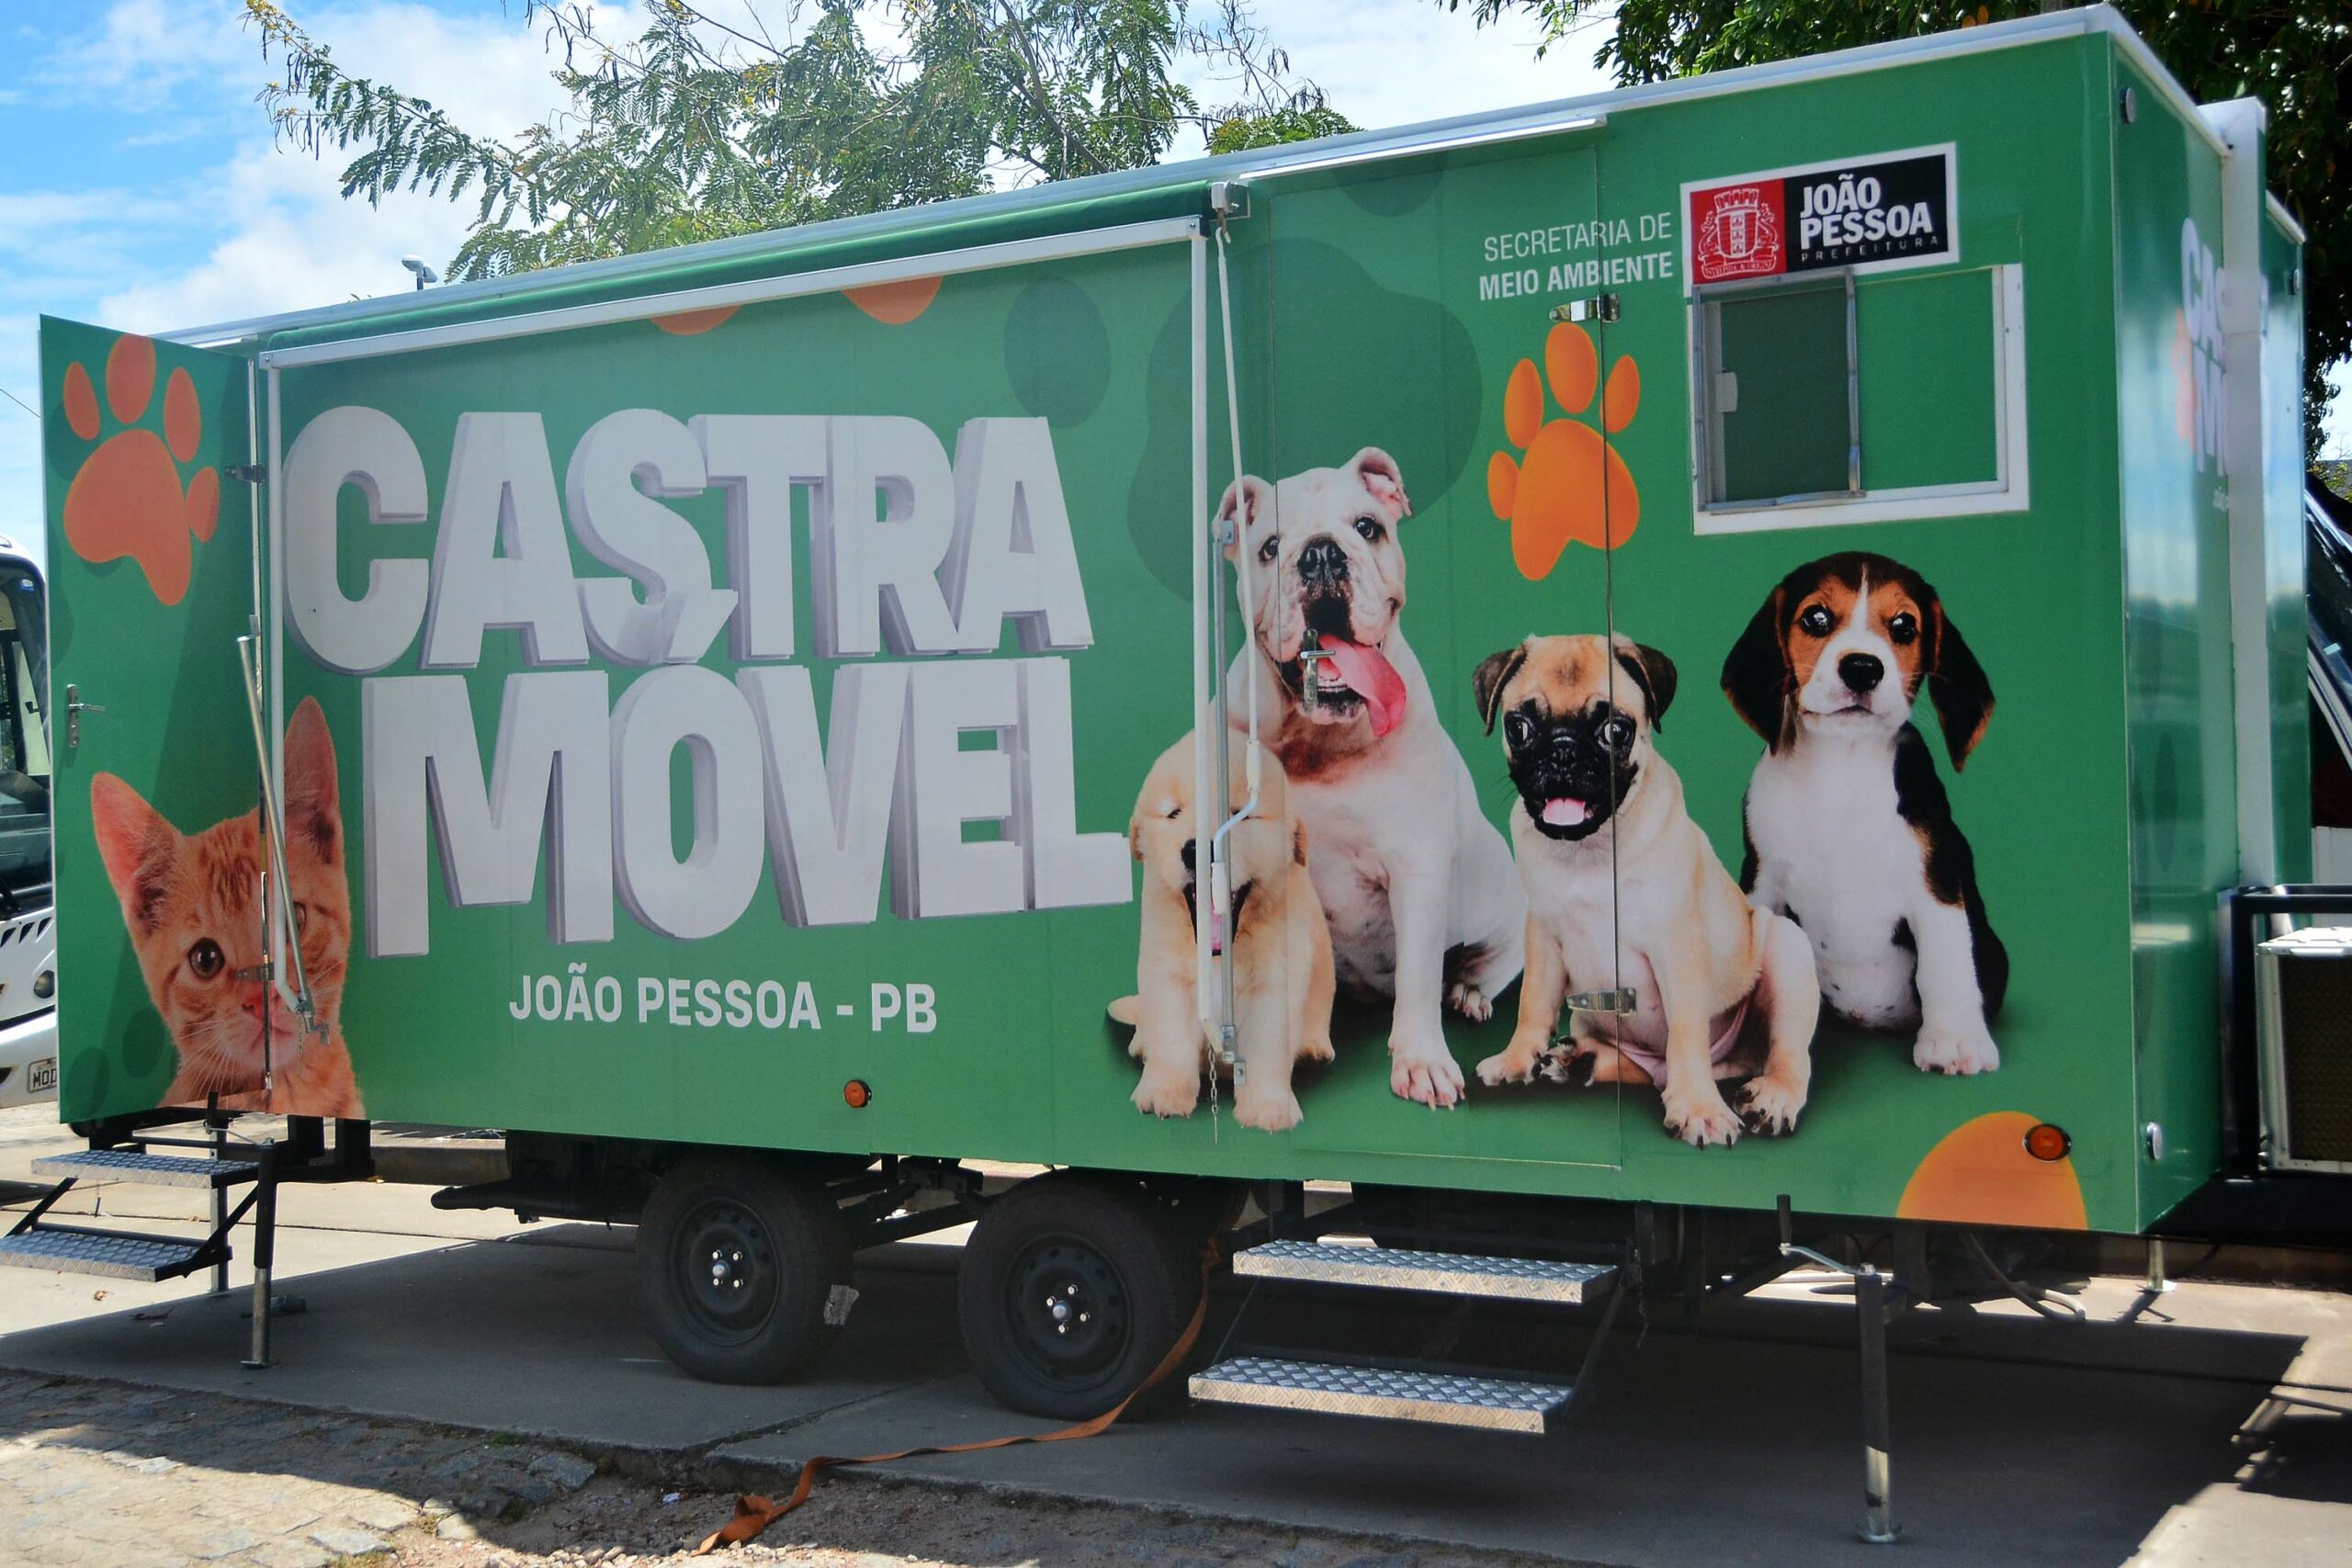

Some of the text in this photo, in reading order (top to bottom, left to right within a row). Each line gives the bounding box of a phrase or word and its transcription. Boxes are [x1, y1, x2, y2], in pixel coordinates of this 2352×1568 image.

[1800, 173, 1882, 219] JOÃO
[1484, 211, 1672, 262] SECRETARIA DE
[1800, 201, 1933, 250] PESSOA
[1801, 235, 1939, 263] PREFEITURA
[1479, 268, 1539, 301] MEIO
[1547, 251, 1673, 292] AMBIENTE
[281, 404, 1096, 675] CASTRA
[509, 962, 937, 1033] JOÃO PESSOA - PB
